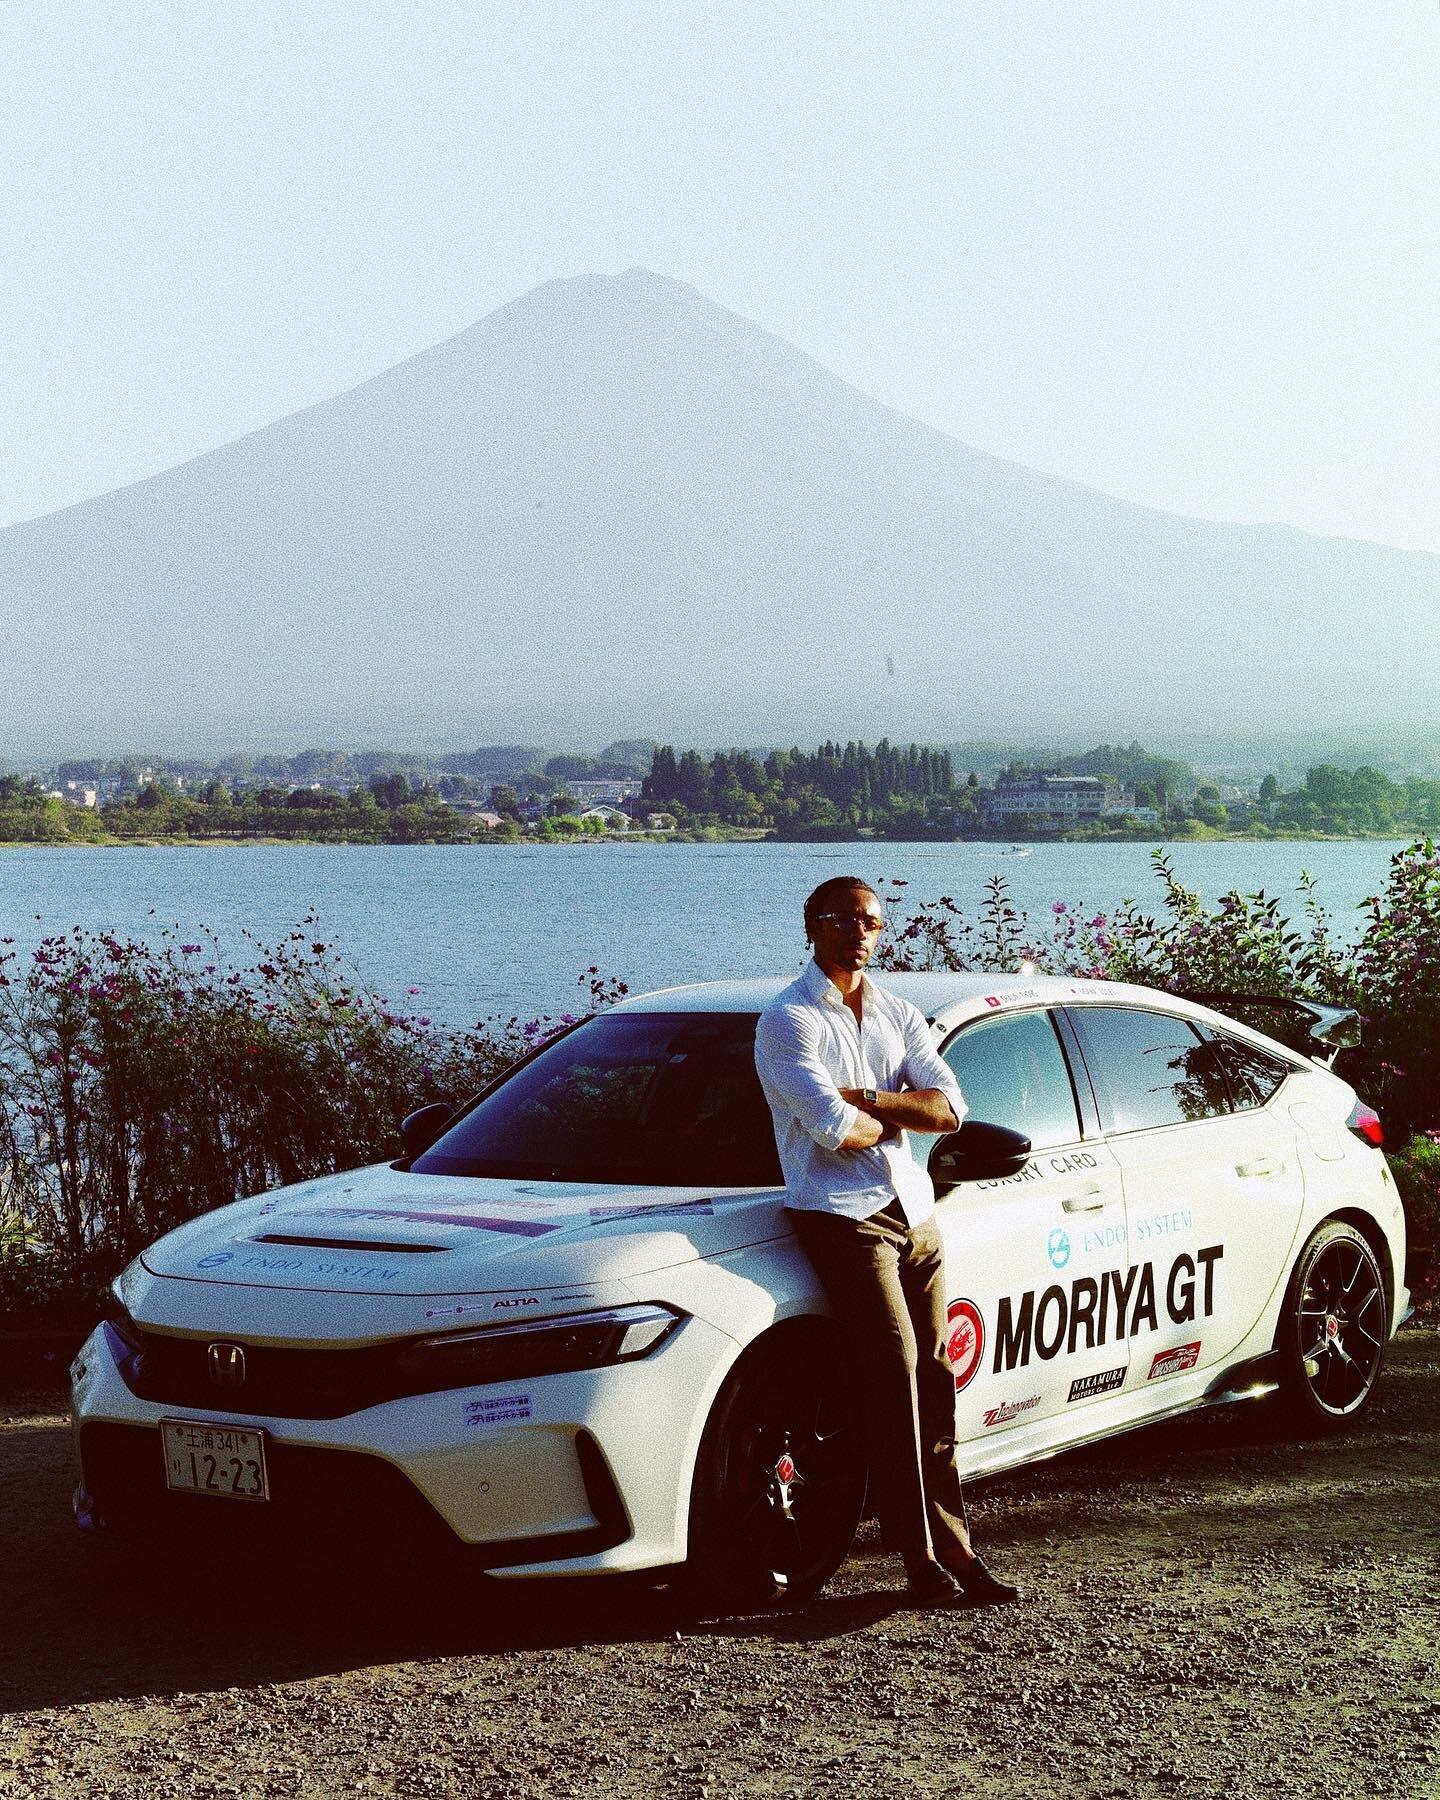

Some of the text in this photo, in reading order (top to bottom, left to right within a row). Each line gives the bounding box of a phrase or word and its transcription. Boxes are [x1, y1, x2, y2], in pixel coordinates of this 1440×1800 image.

[1050, 1153, 1098, 1173] CARD
[1083, 1210, 1193, 1252] ENDO SYSTEM
[493, 1297, 541, 1309] ALTIA
[993, 1244, 1224, 1375] MORIYA GT
[1072, 1368, 1124, 1393] NAKAMURA
[186, 1428, 239, 1453] 土浦 341
